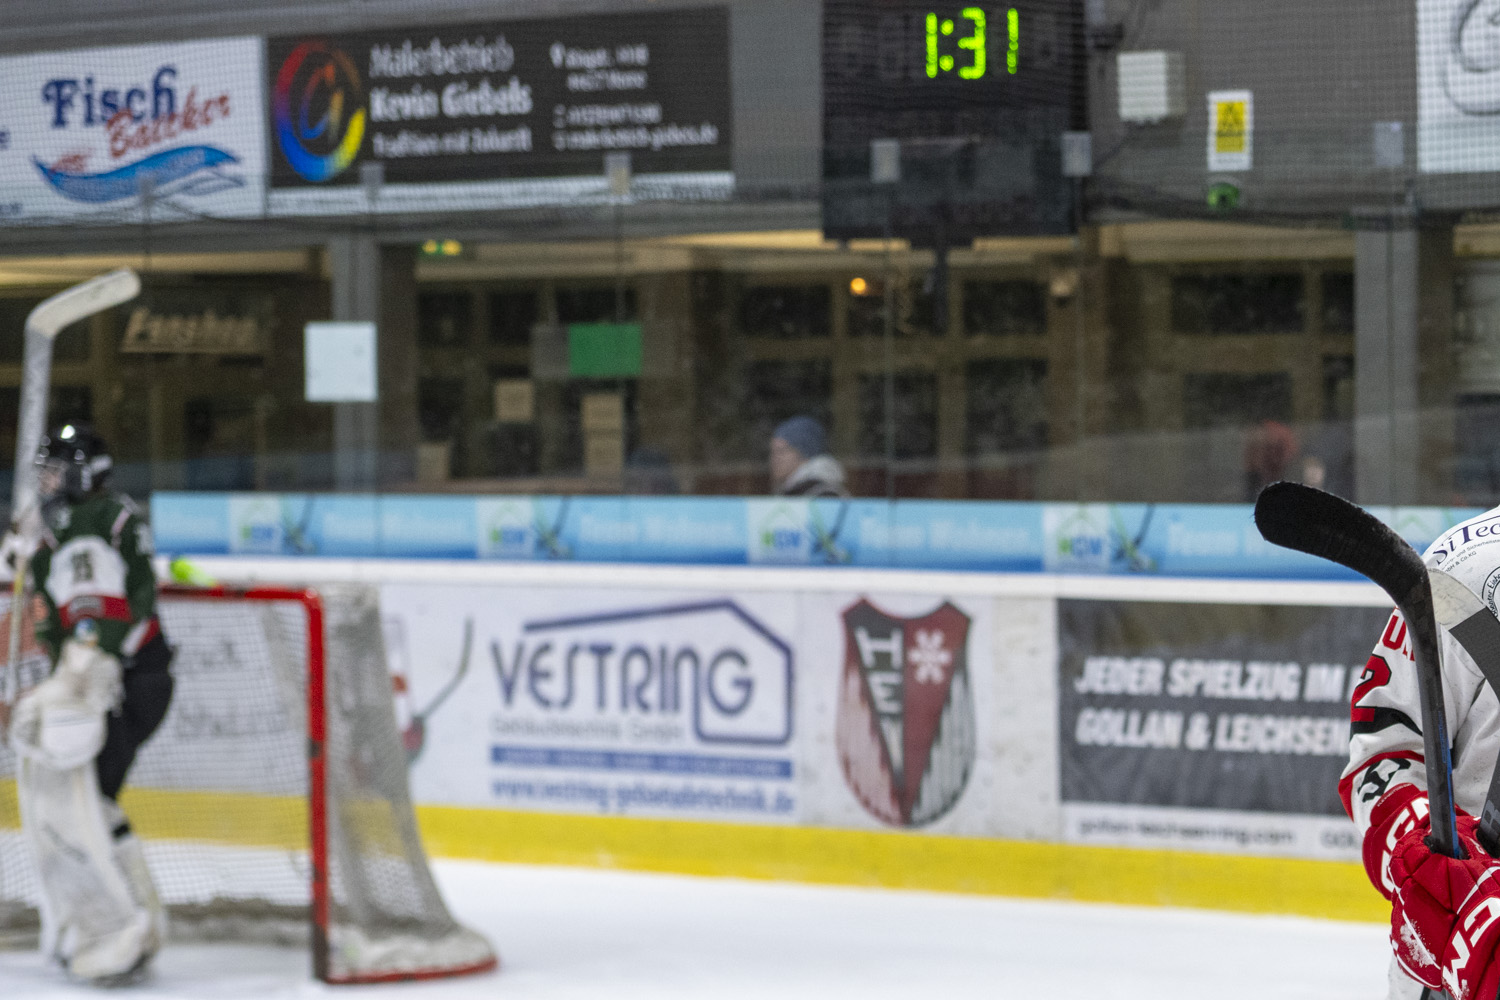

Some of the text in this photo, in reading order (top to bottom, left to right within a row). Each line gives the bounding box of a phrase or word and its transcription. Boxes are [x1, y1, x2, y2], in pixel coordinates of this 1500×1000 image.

[925, 8, 1018, 78] 1:31
[42, 65, 177, 128] Fisch
[491, 640, 755, 716] VESTRING
[1074, 656, 1165, 695] JEDER
[1167, 659, 1300, 700] SPIELZUG
[1304, 663, 1346, 703] IM
[1075, 707, 1184, 749] GOLLAN
[1185, 712, 1211, 750] &
